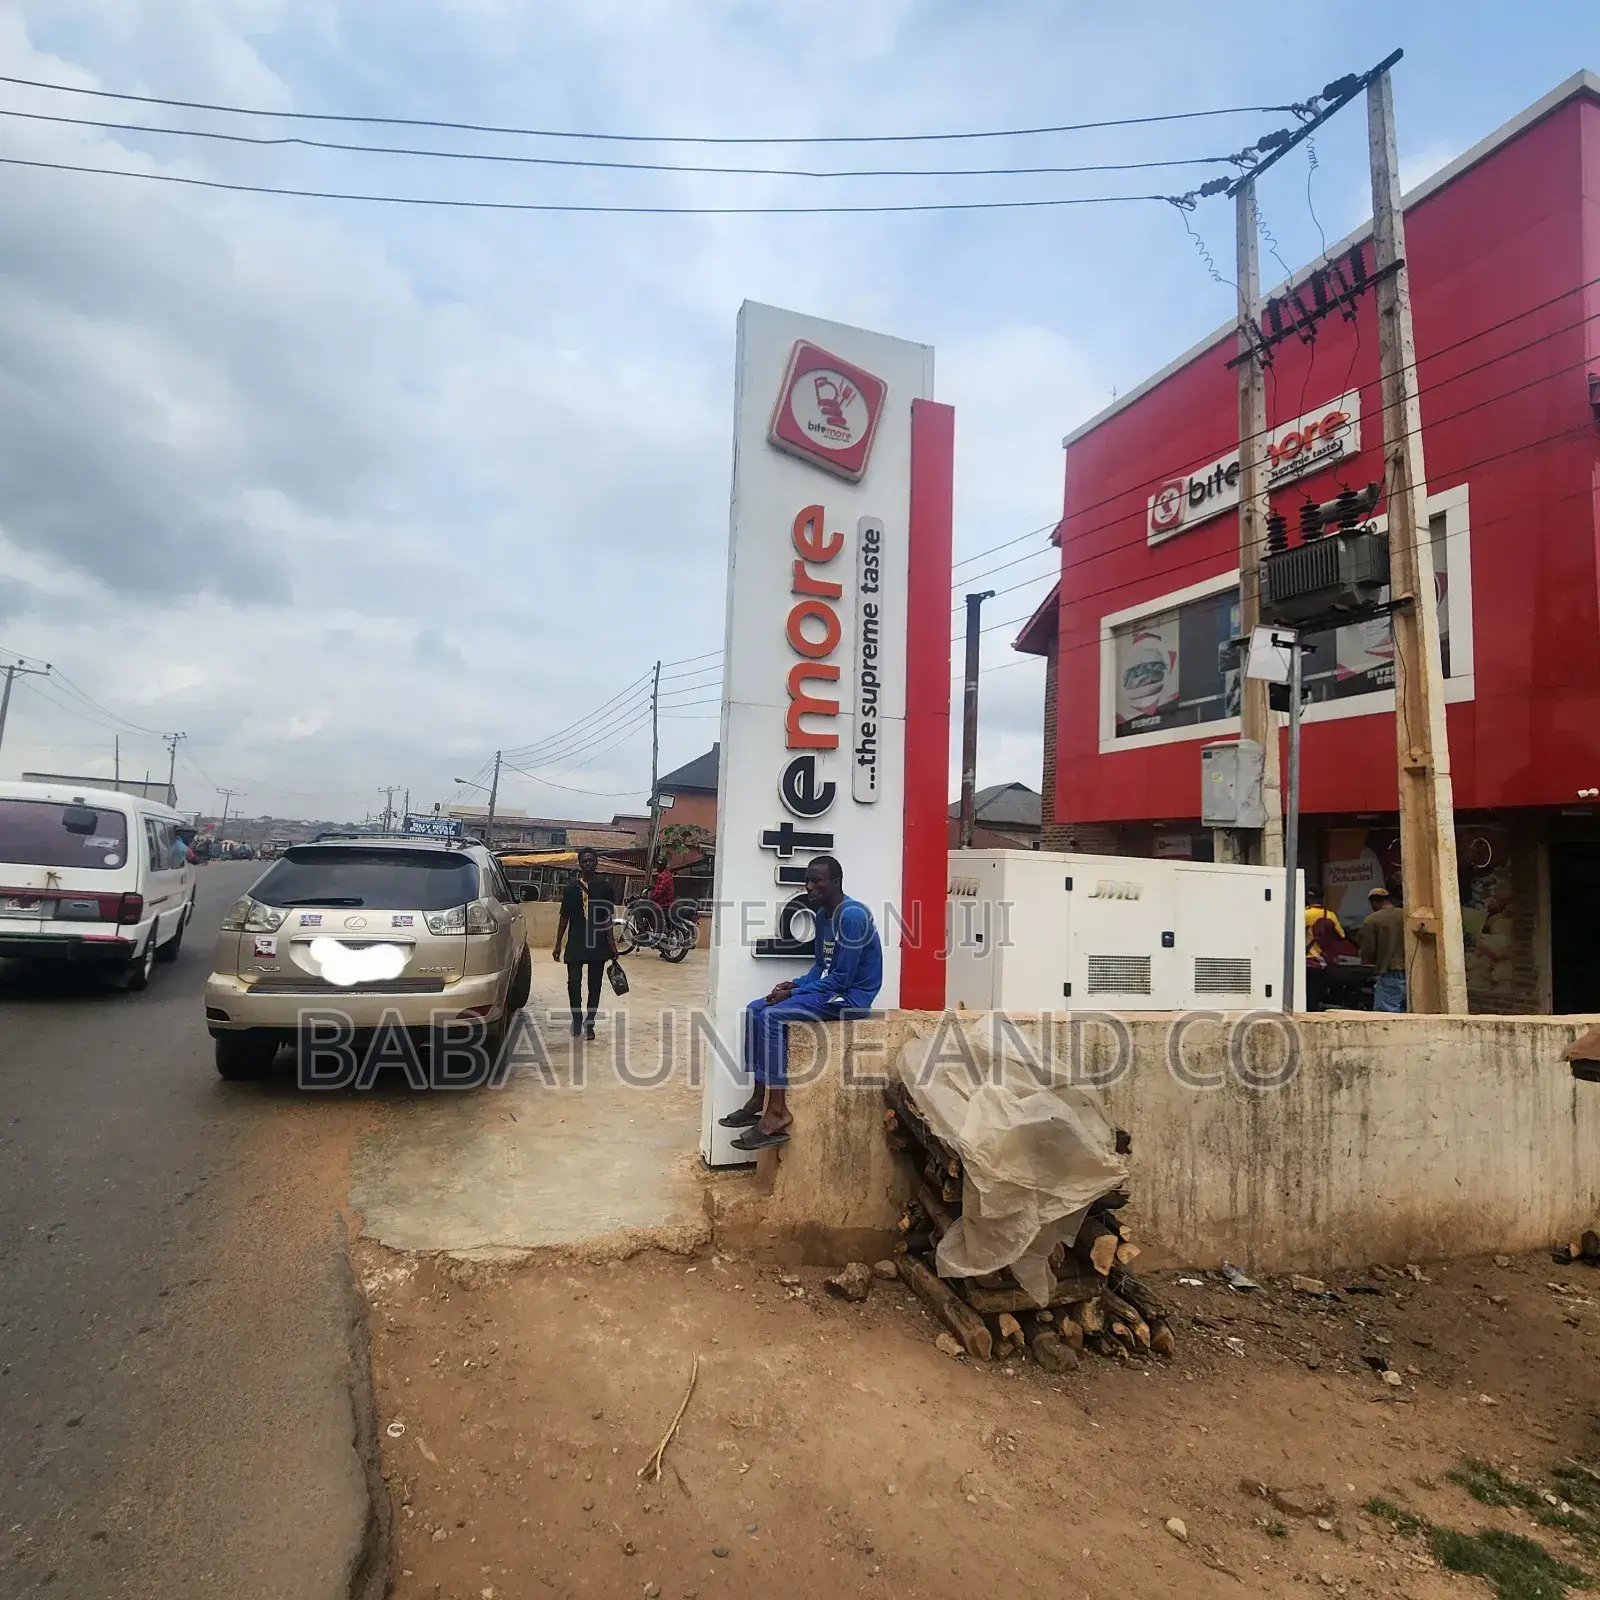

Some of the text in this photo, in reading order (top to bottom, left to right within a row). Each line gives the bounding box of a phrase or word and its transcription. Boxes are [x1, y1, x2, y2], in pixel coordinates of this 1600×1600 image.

[807, 421, 852, 439] bitemore
[1313, 442, 1339, 458] taste
[1189, 411, 1350, 507] biteore
[861, 528, 881, 594] taste
[861, 602, 881, 718] supreme
[1088, 879, 1143, 901] JMG
